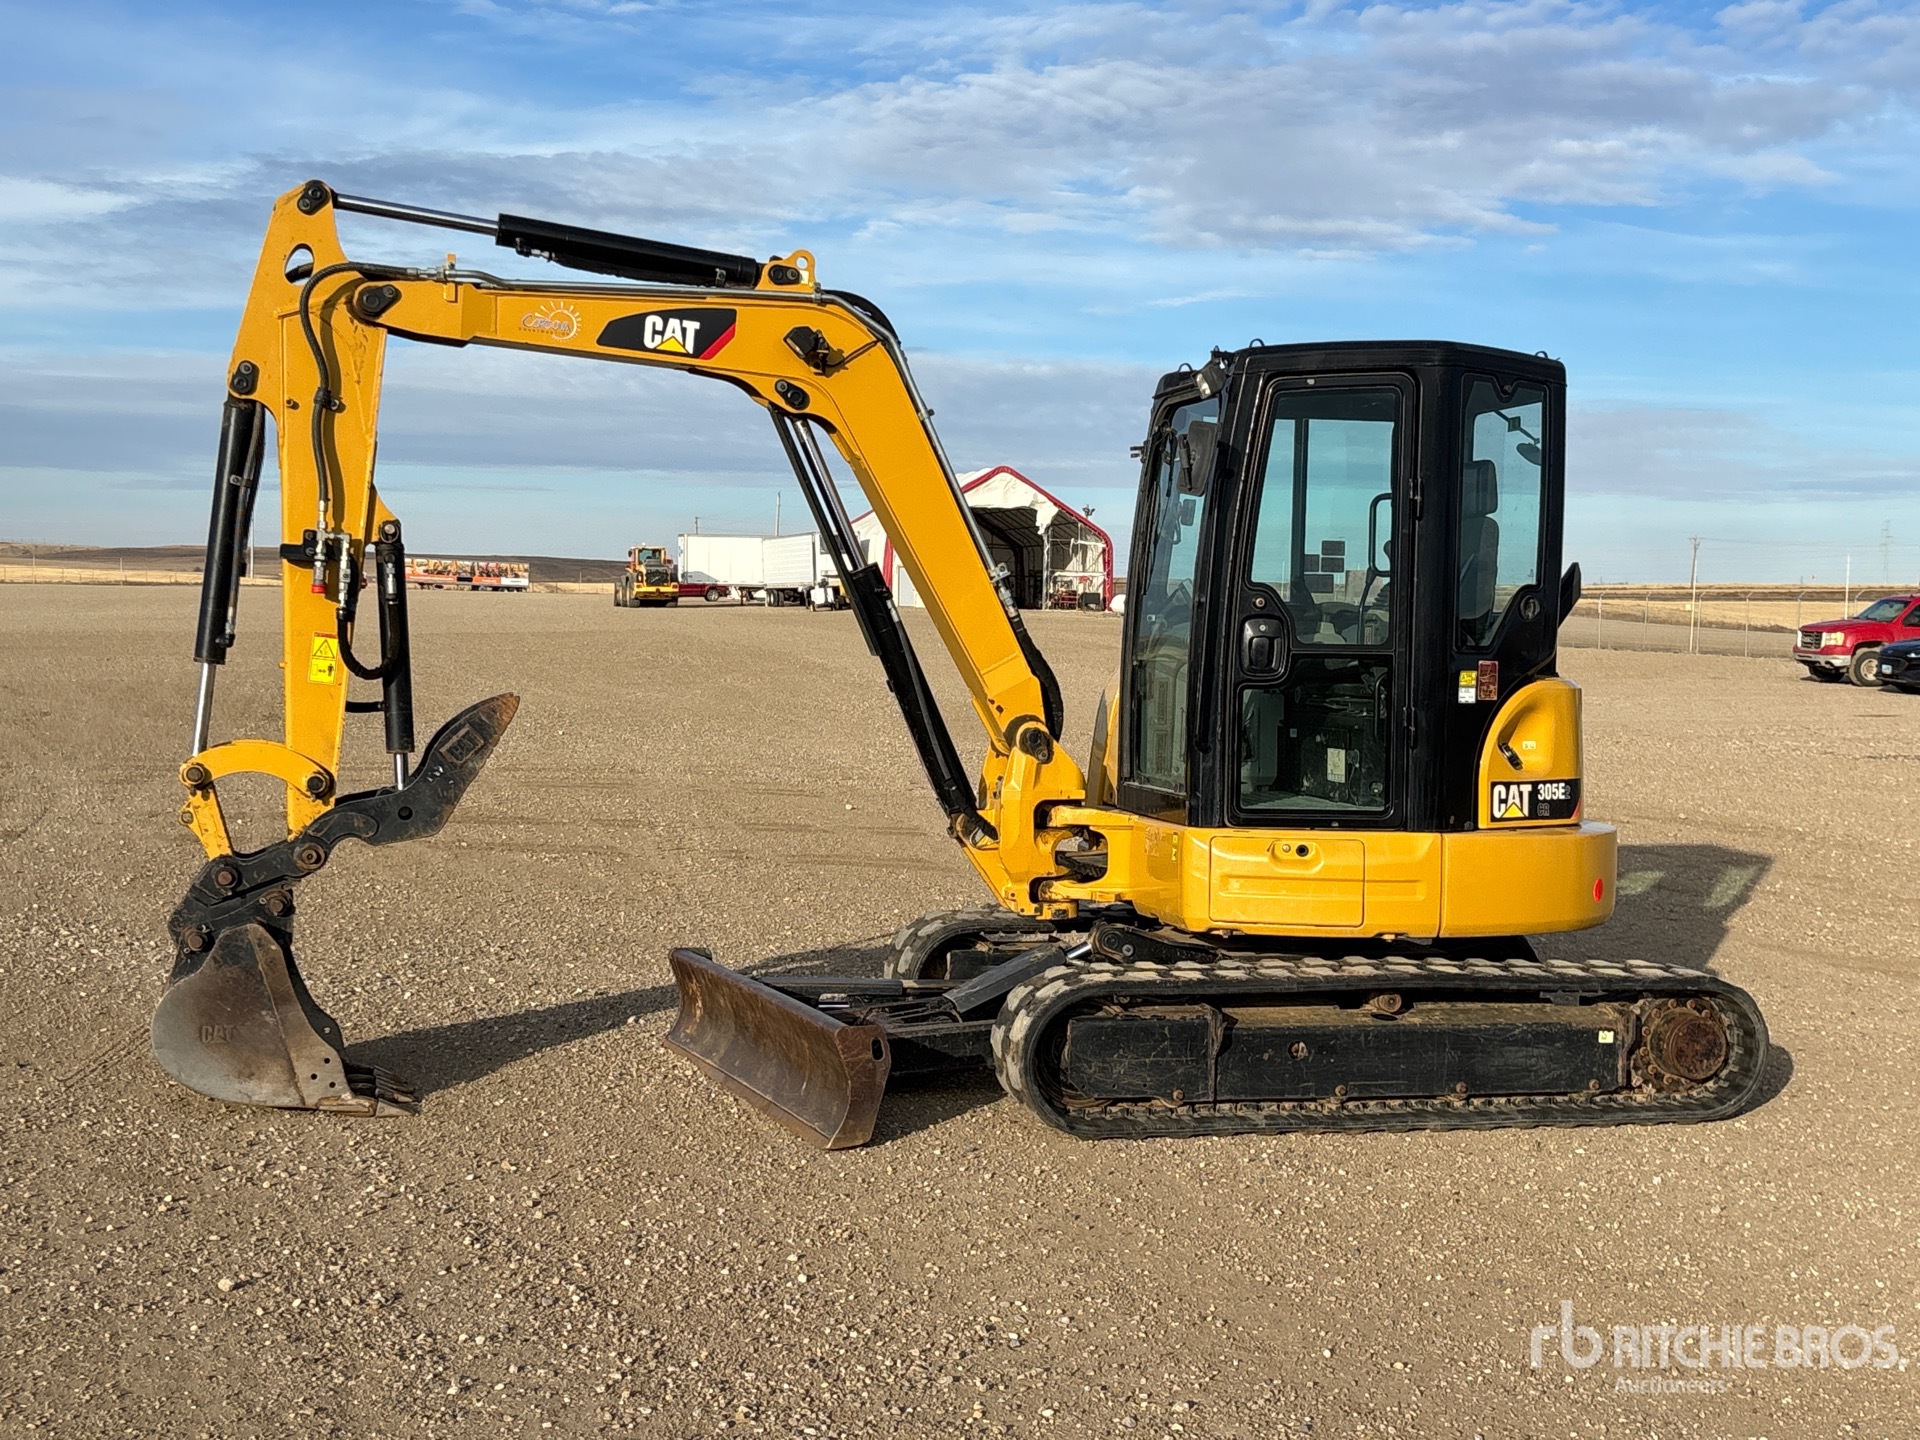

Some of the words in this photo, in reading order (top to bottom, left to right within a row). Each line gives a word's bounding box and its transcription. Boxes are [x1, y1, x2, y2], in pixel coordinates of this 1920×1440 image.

[643, 314, 701, 354] CAT
[1493, 784, 1532, 818] CAT
[200, 1024, 236, 1043] CAT
